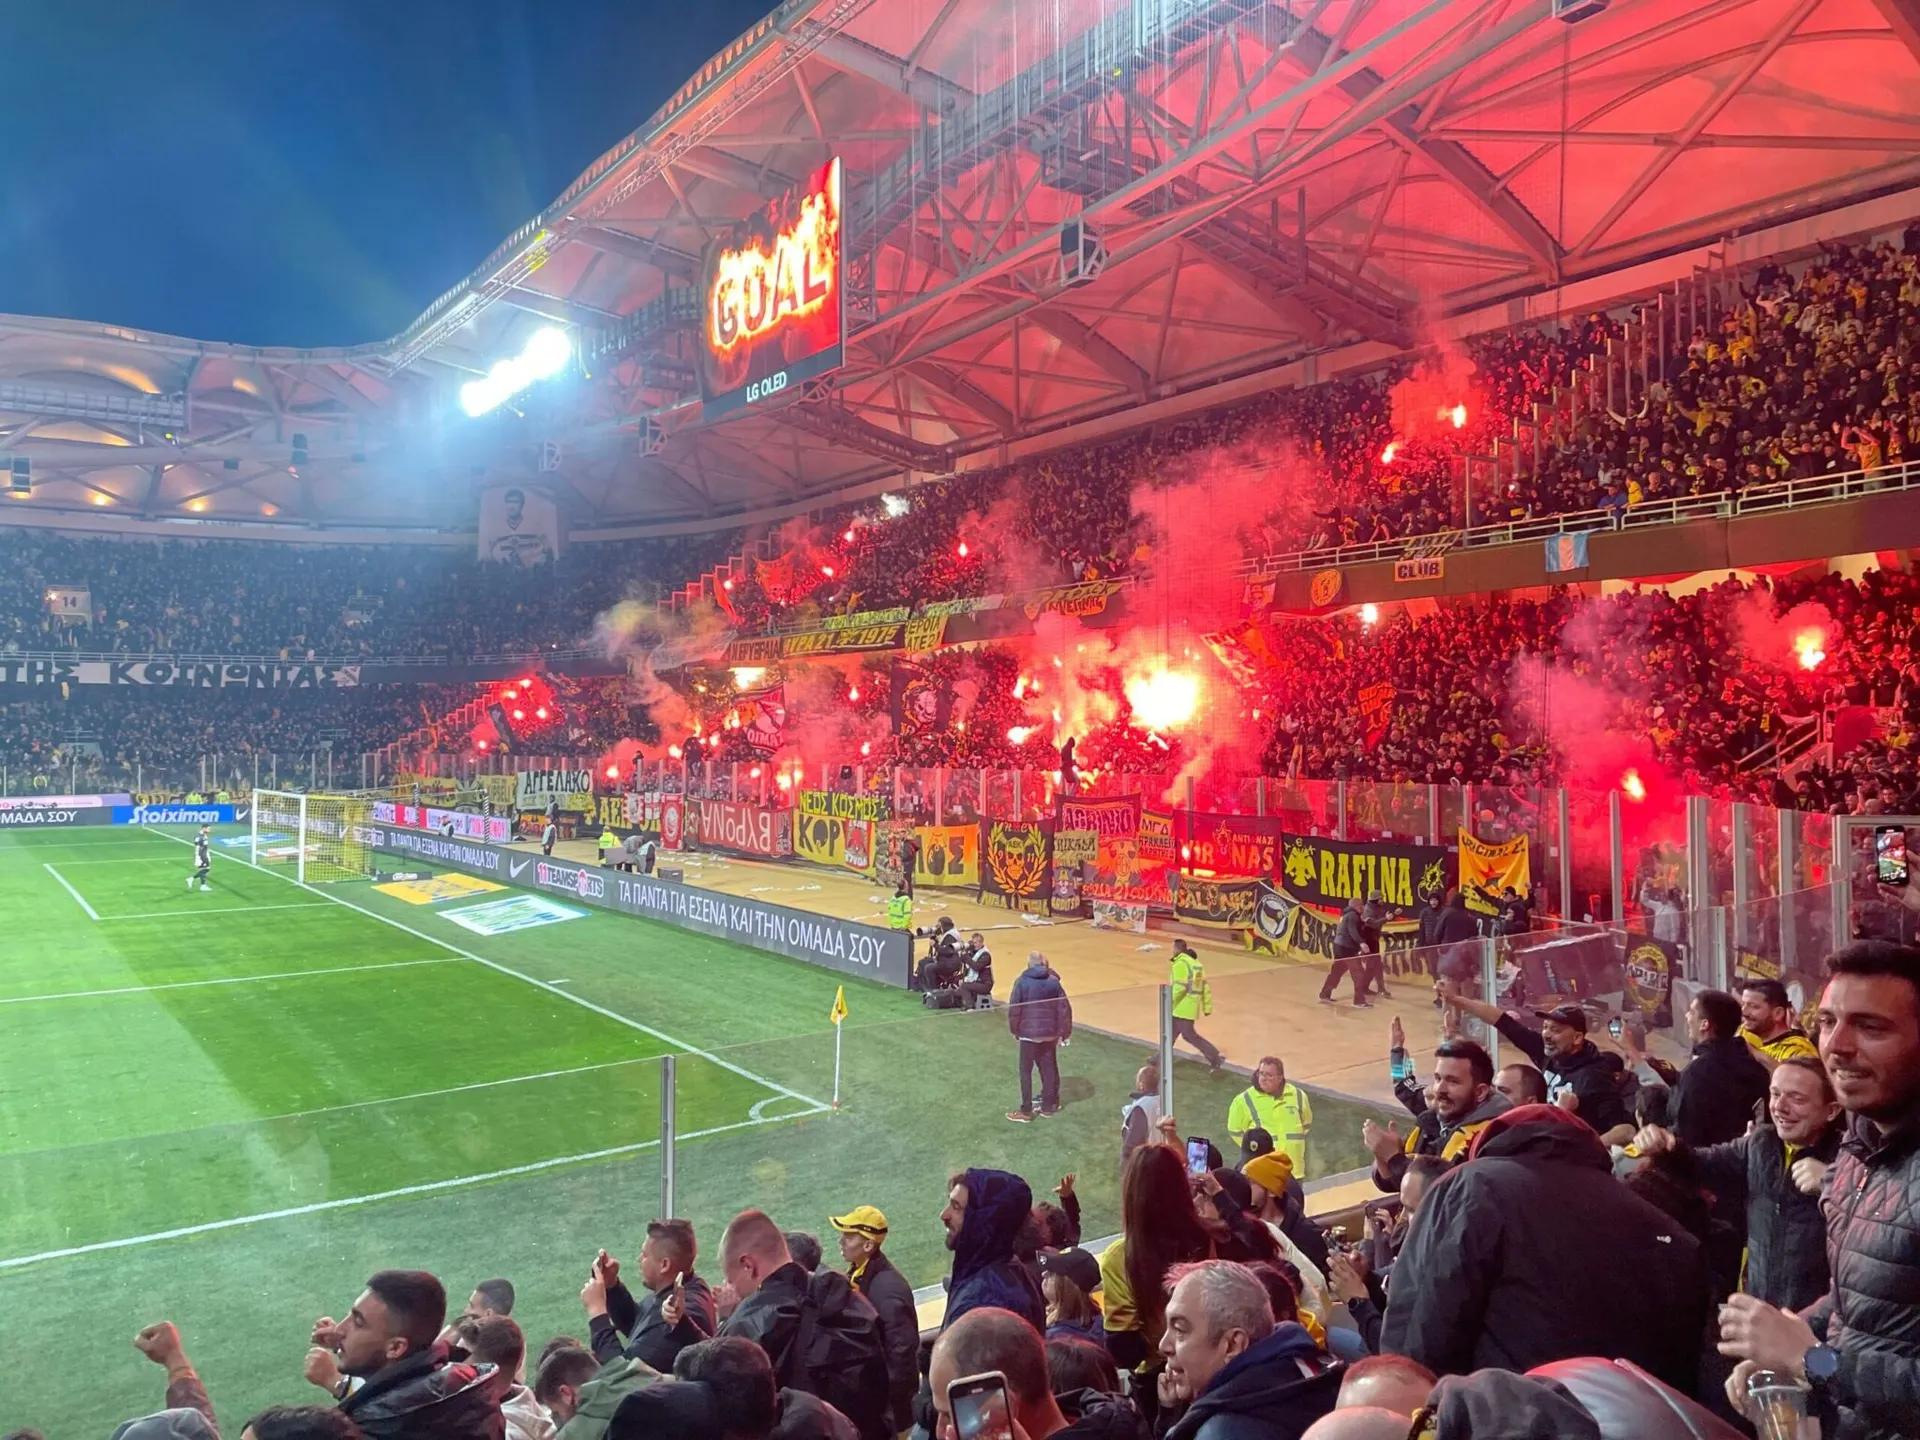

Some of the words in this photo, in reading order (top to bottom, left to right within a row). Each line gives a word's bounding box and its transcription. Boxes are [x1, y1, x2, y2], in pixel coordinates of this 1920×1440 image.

[713, 212, 829, 346] GOAL
[746, 383, 760, 402] LG
[760, 371, 787, 394] OLED
[63, 596, 77, 608] 14
[858, 625, 900, 645] 1975
[47, 810, 78, 823] ΣΟΥ
[128, 805, 220, 824] Stoiximan
[1180, 839, 1274, 871] VIRNAS
[1320, 849, 1414, 906] RAFINA
[618, 879, 631, 904] ΤΑ
[633, 882, 668, 912] ΠΑΝΤΑ
[670, 891, 687, 917] ΓΙΑ
[689, 895, 728, 928] ΕΣΕΝΑ
[729, 904, 753, 934] ΚΑΙ
[755, 910, 785, 942] ΤΗΝ
[788, 918, 845, 959] ΟΜΑΔΑ
[848, 932, 886, 968] ΣΟΥ
